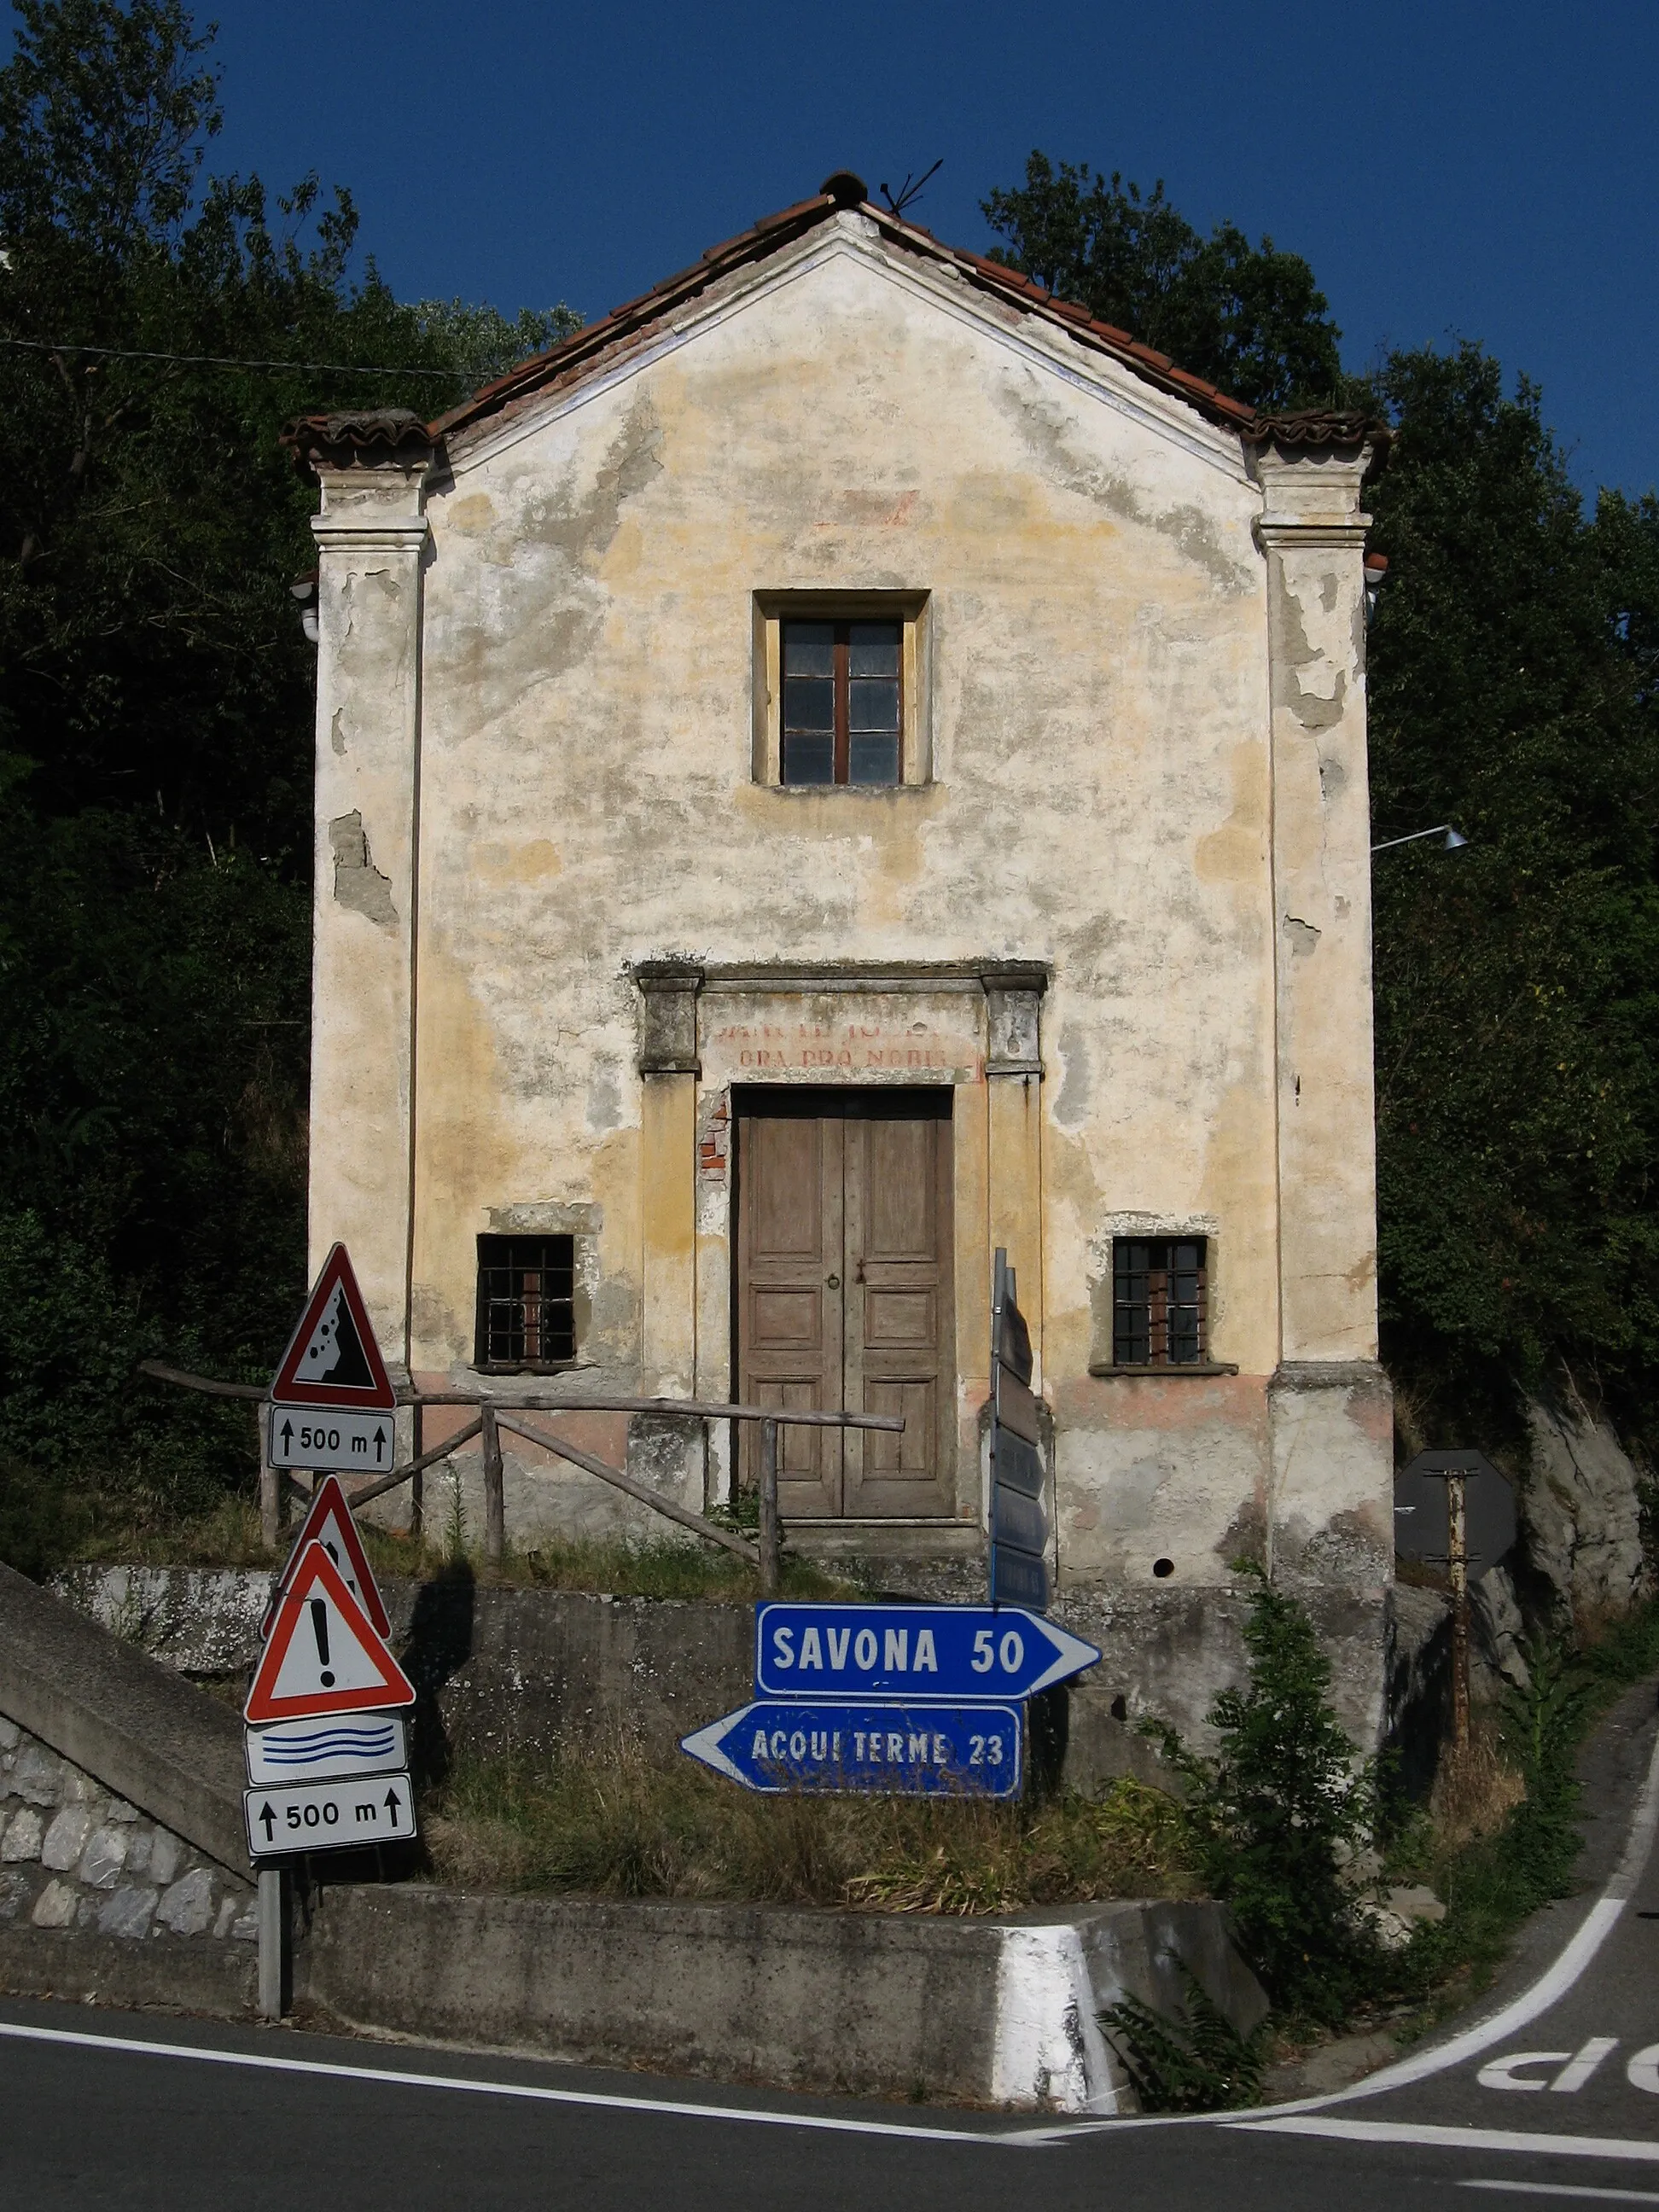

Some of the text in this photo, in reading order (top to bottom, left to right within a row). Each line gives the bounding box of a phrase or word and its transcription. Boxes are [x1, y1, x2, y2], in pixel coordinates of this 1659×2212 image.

[740, 1050, 790, 1067] ORA
[801, 1050, 852, 1067] PRO
[300, 1427, 367, 1452] 500 m
[773, 1627, 1024, 1674] SAVONA 50
[751, 1730, 1004, 1766] ACQUI TERME 23
[287, 1802, 376, 1829] 500 m
